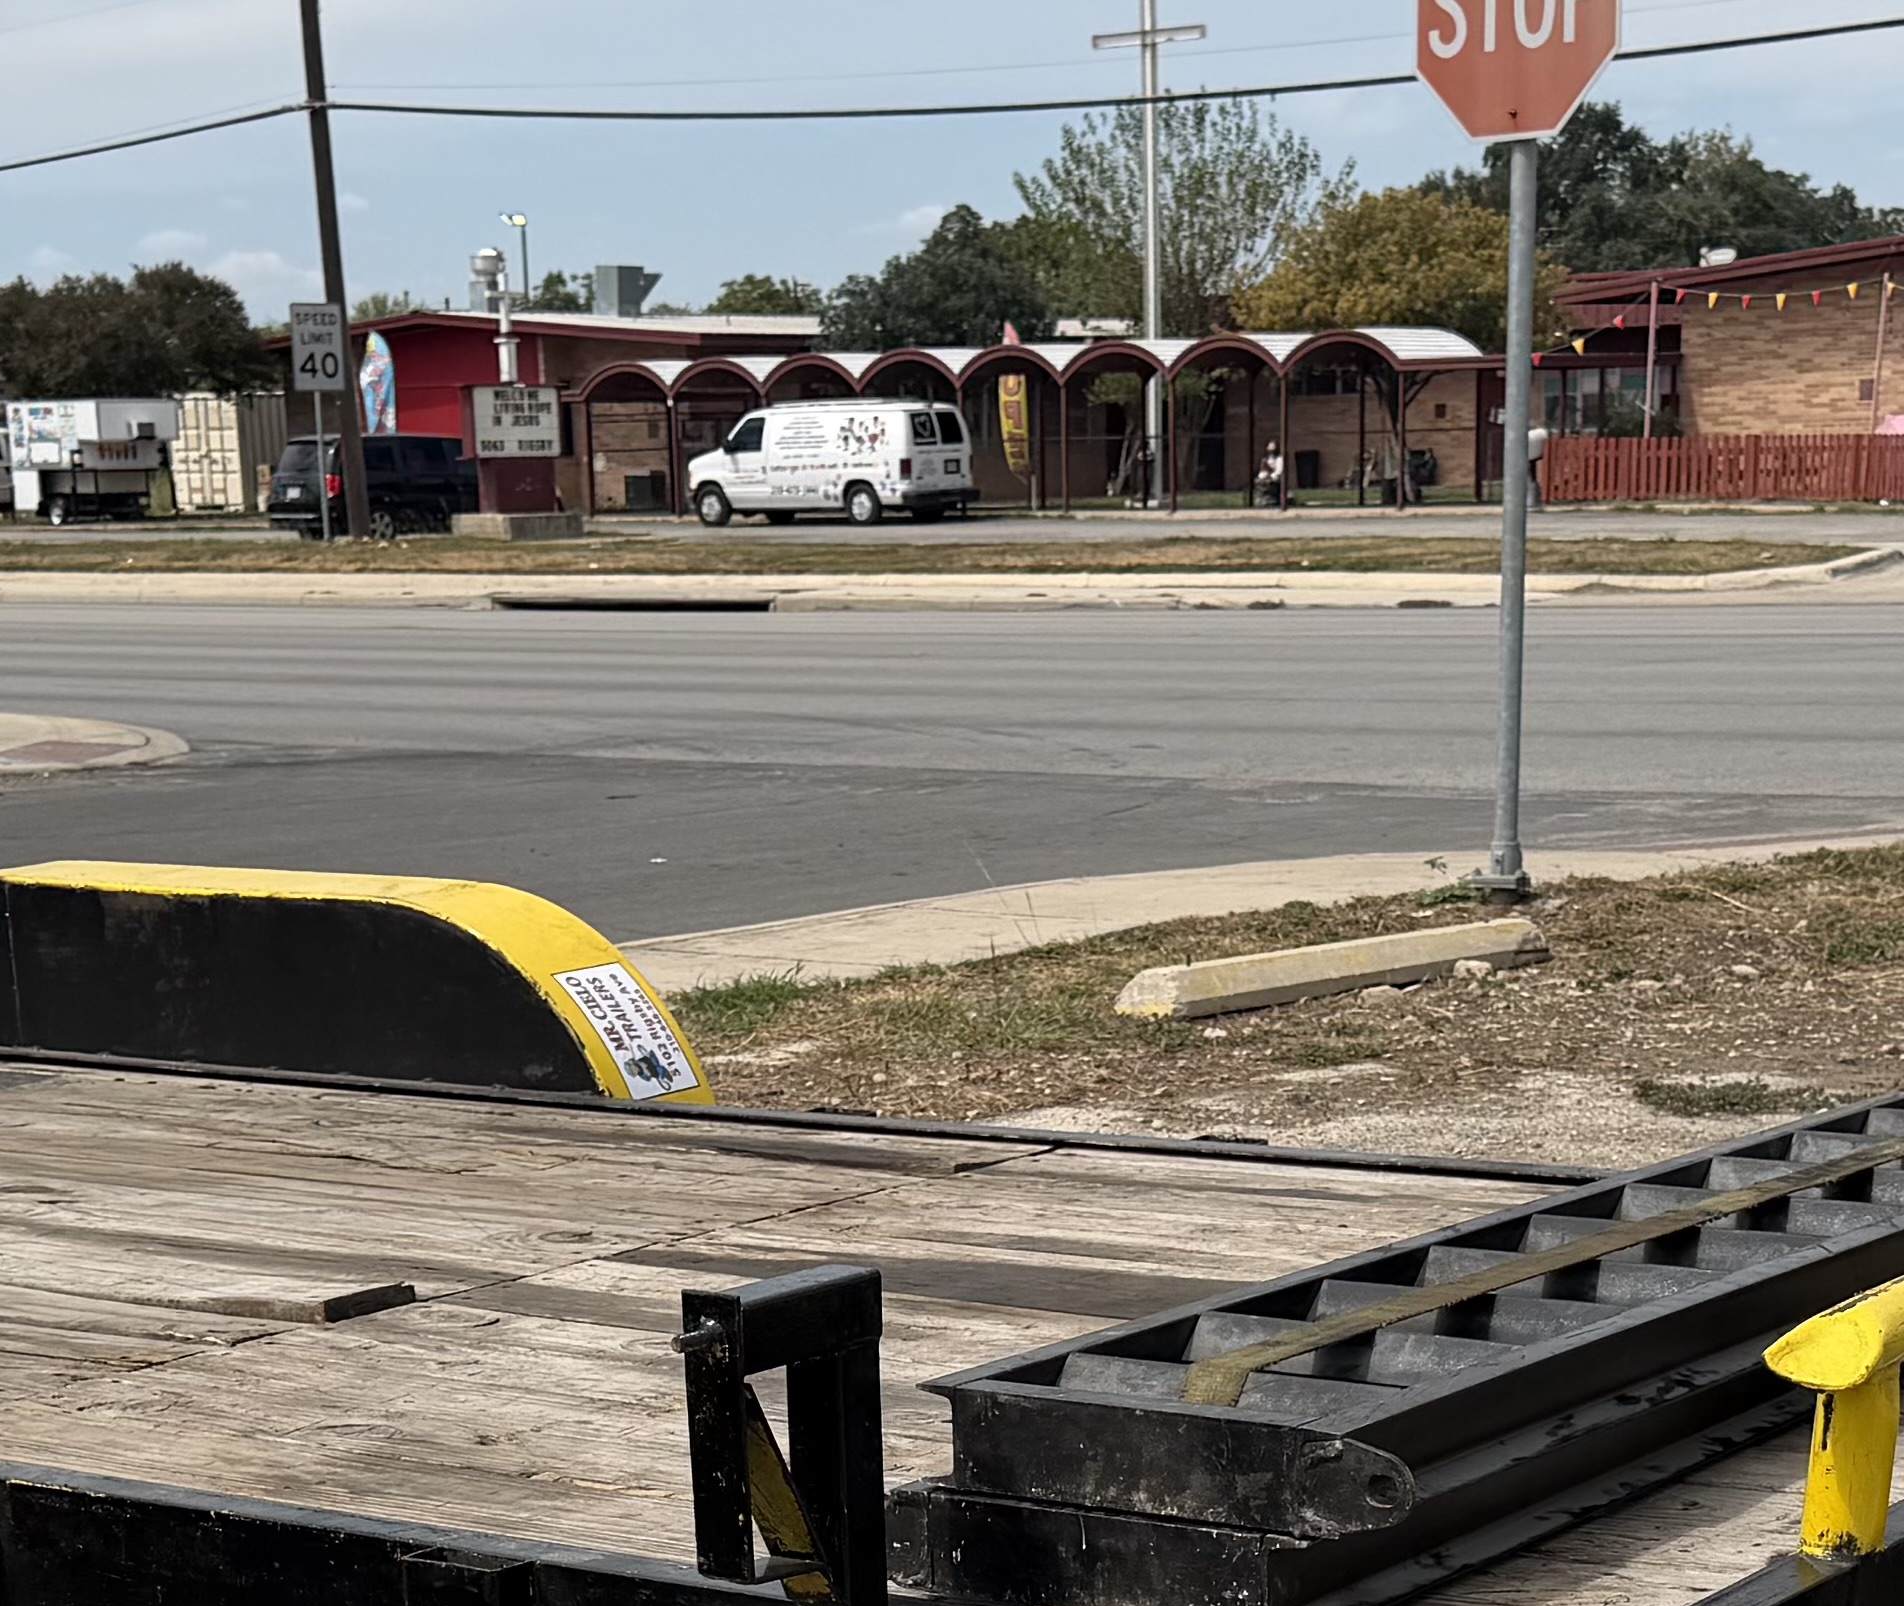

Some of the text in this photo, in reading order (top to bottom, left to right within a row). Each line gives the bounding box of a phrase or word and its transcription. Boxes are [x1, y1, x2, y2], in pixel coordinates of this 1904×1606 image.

[295, 313, 338, 326] SPEED
[300, 332, 333, 346] LIMIT
[299, 352, 339, 379] 40
[565, 976, 608, 1021] CIELO
[586, 977, 642, 1042] TRAILERS
